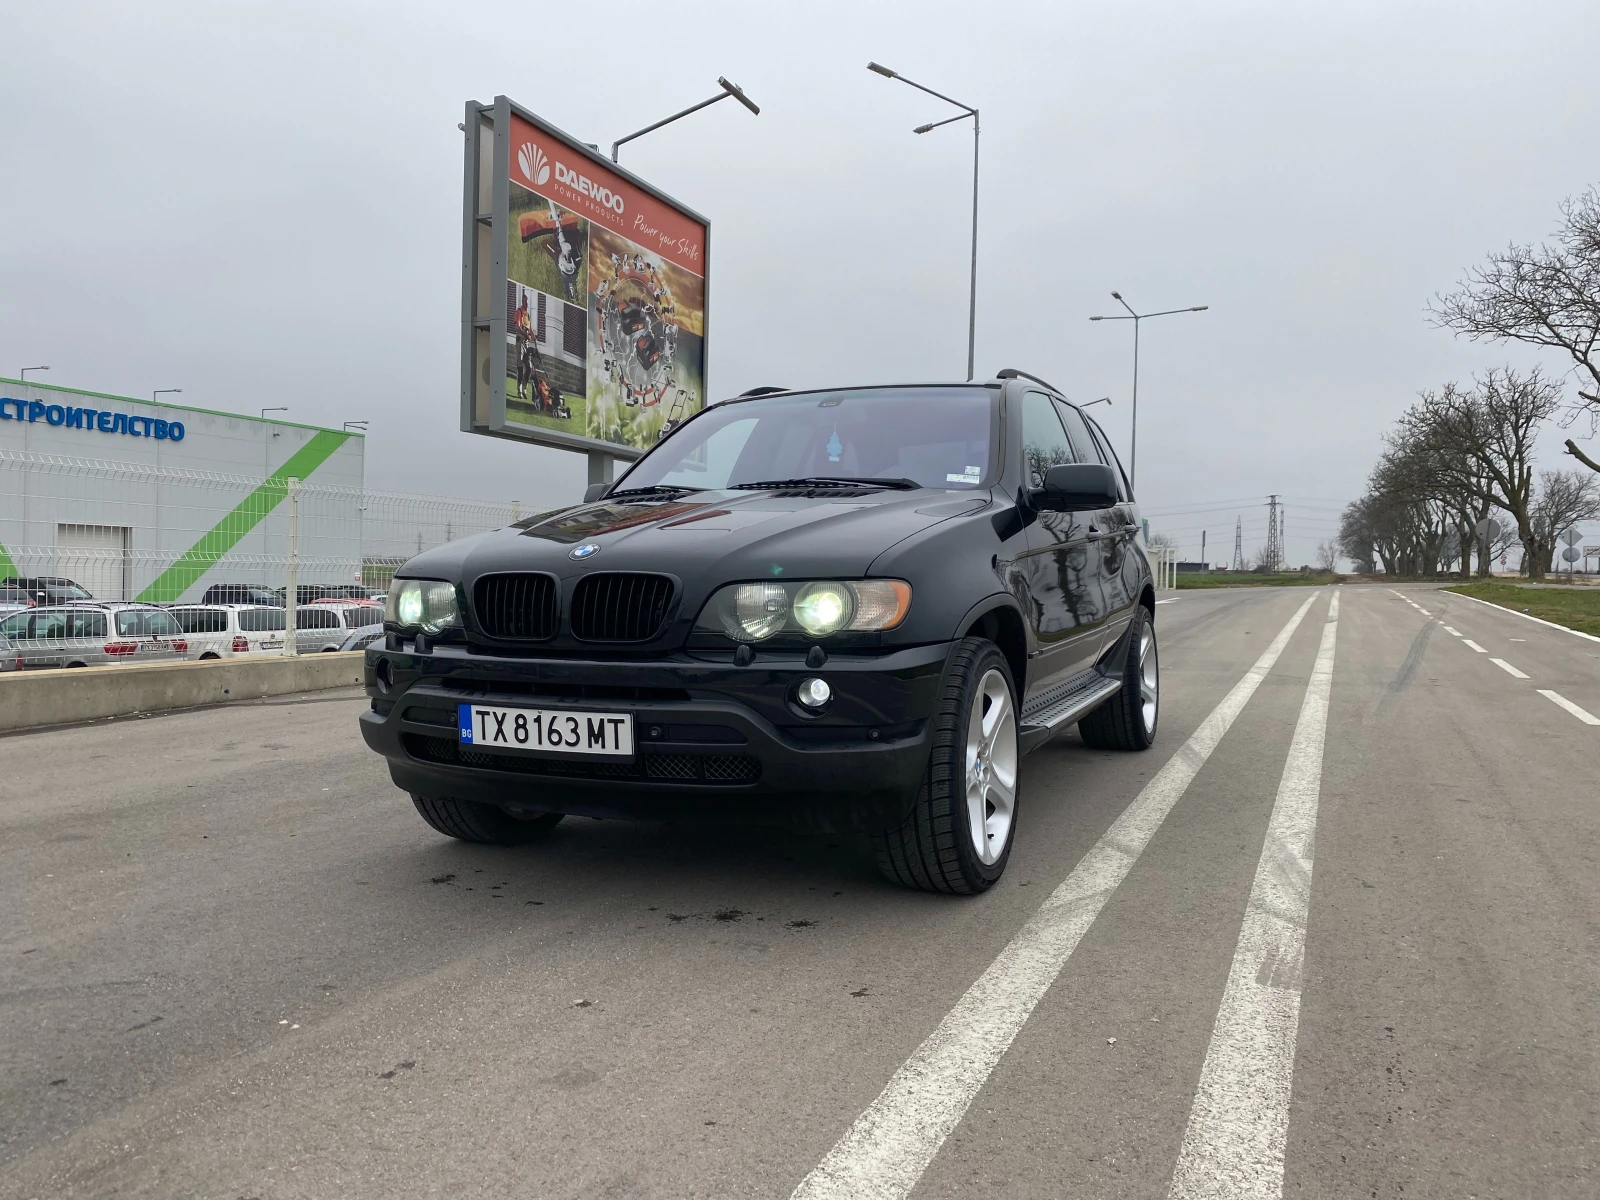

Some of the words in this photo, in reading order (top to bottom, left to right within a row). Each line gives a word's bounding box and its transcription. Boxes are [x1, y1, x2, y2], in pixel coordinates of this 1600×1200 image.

[554, 183, 581, 203] POWER
[585, 201, 624, 226] PRODUCTS
[555, 161, 624, 214] DAEWOO
[633, 213, 659, 236] Power
[659, 232, 677, 248] your
[677, 238, 699, 260] Skills
[0, 398, 185, 441] СТРОИТЕЛСТВО
[461, 728, 472, 738] BG
